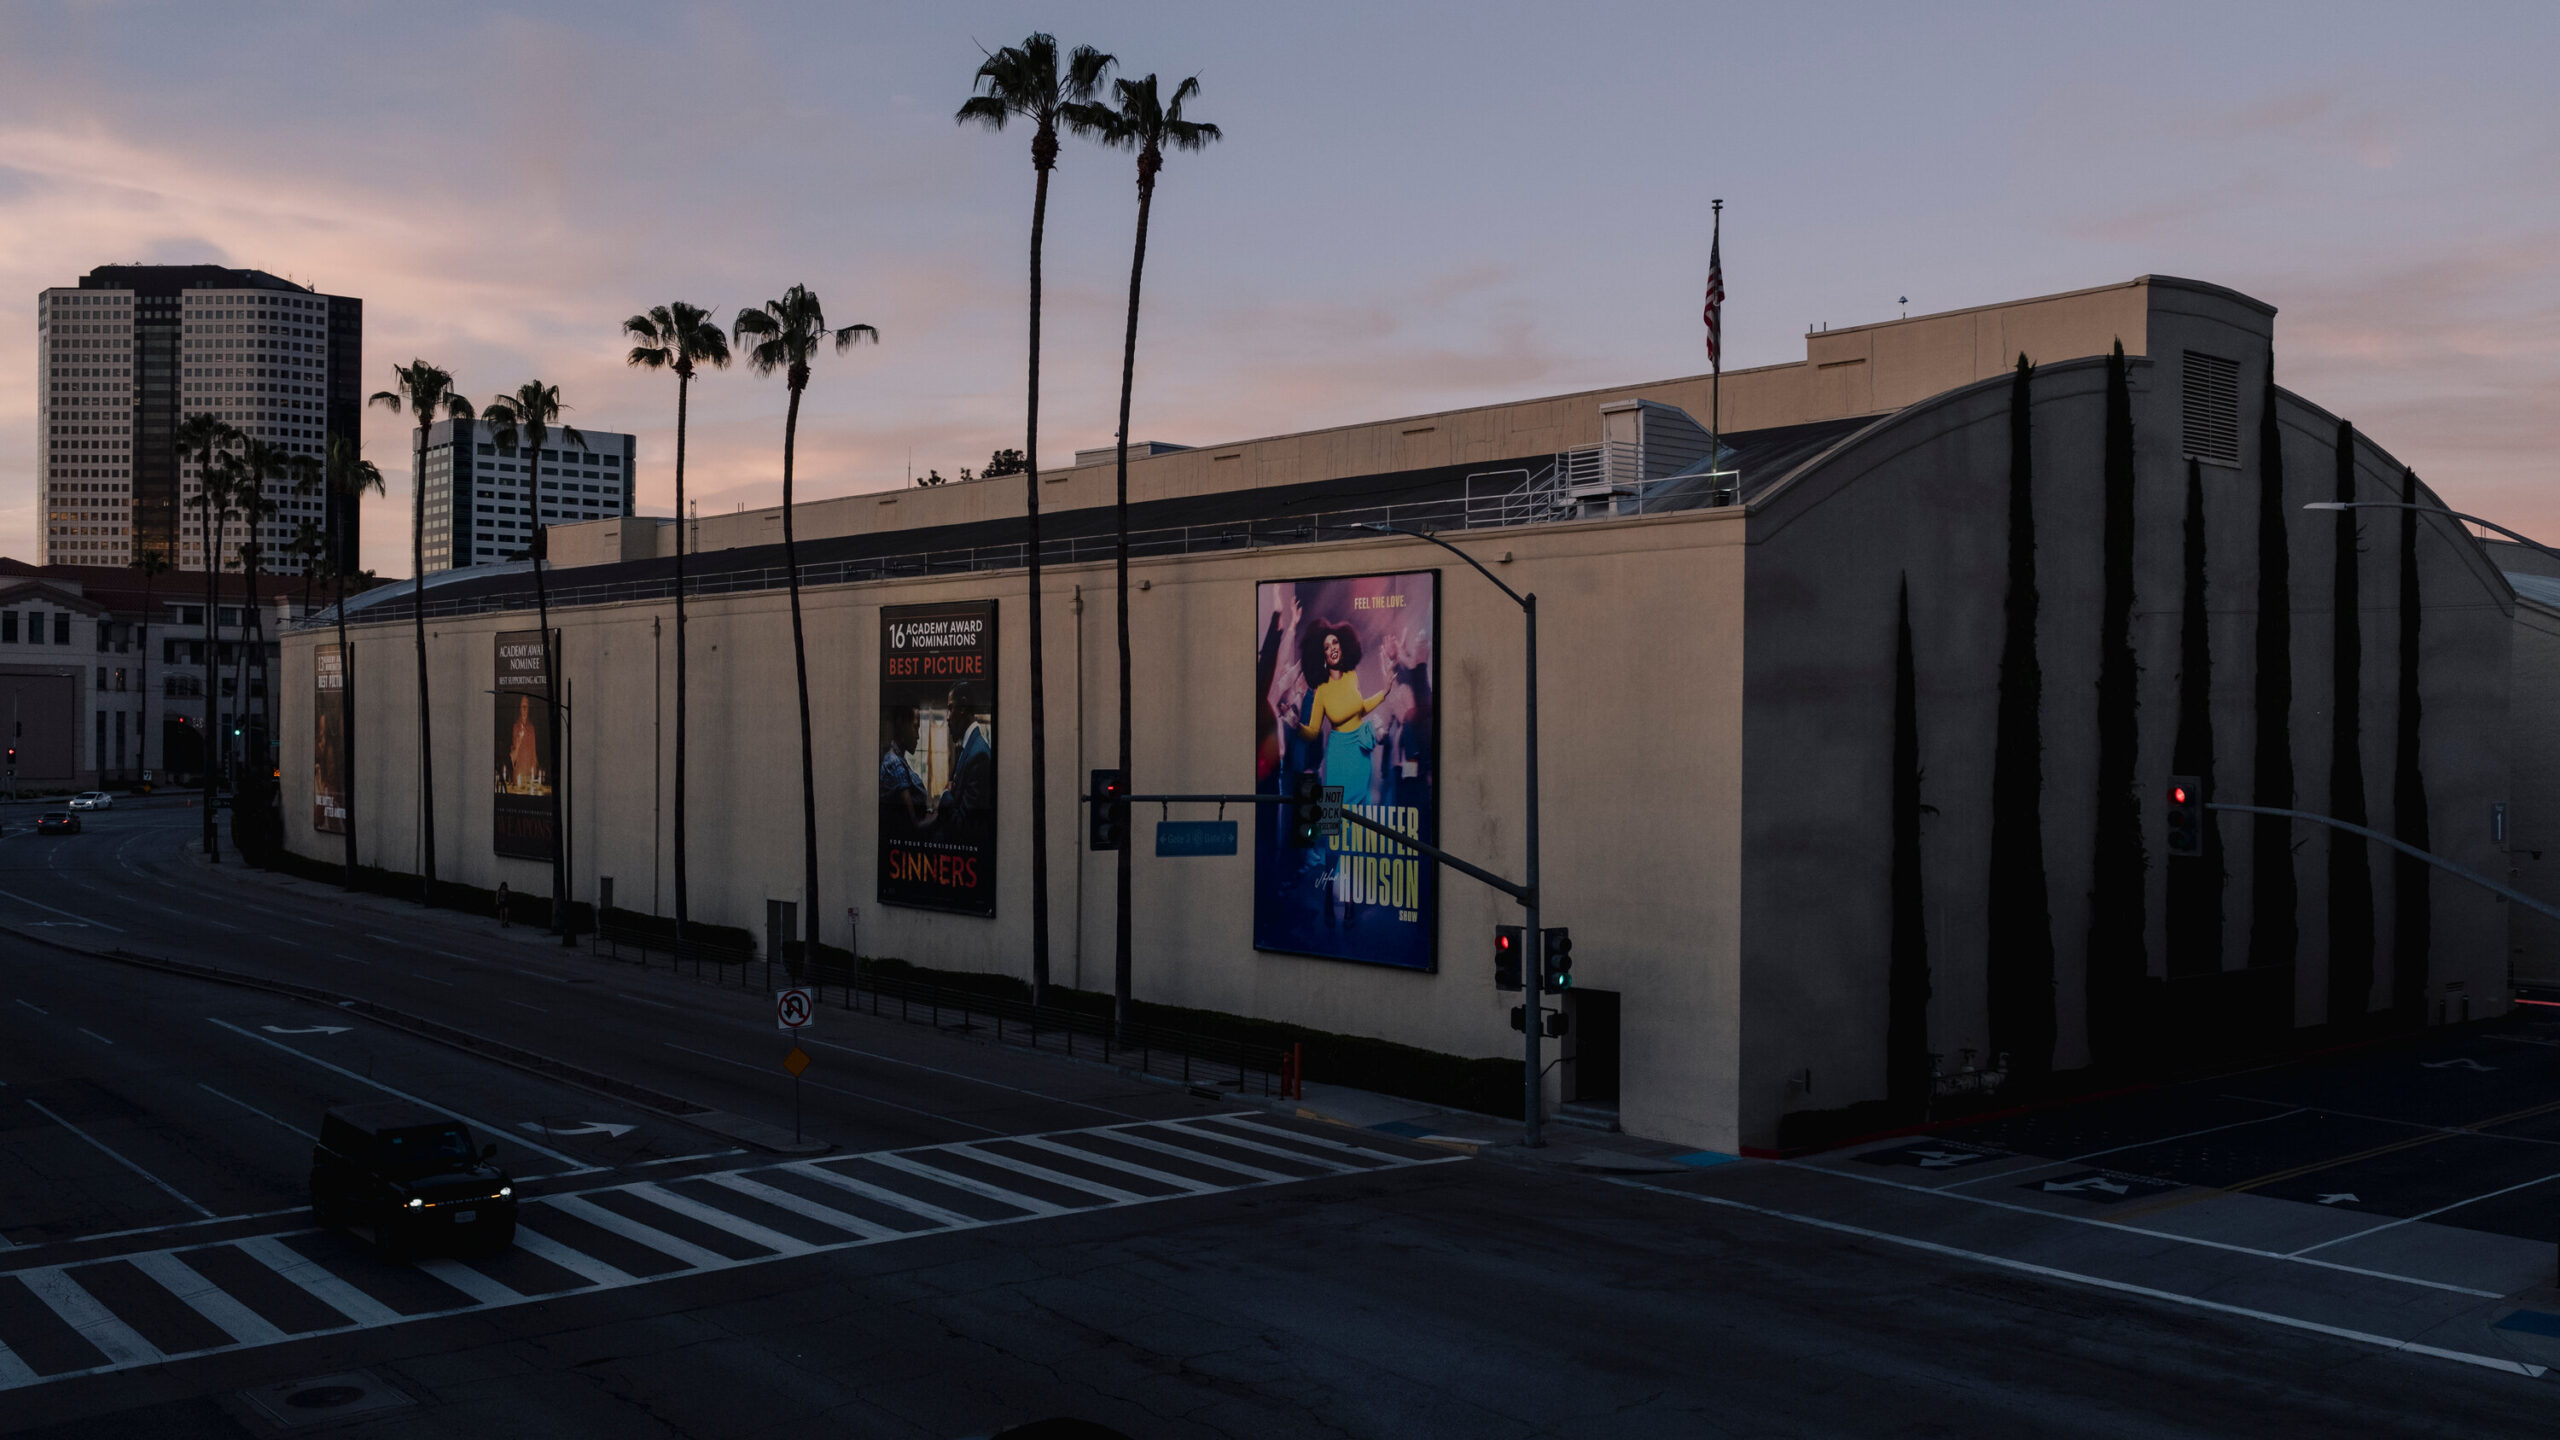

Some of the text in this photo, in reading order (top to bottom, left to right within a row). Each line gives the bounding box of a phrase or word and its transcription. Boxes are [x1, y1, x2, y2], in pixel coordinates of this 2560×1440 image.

[1354, 594, 1407, 609] FEEL THE LOVE.
[889, 620, 983, 649] 16 ACADEMY AWARD
[911, 634, 976, 648] NOMINATIONS
[500, 645, 527, 657] ACADEMY
[510, 658, 540, 670] NOMINEE
[889, 655, 983, 676] BEST PICTURE
[1325, 791, 1341, 803] NOT
[1322, 808, 1339, 819] OCK
[889, 849, 977, 888] SINNERS
[1339, 855, 1418, 909] HUDSON
[1397, 910, 1417, 922] SHOW
